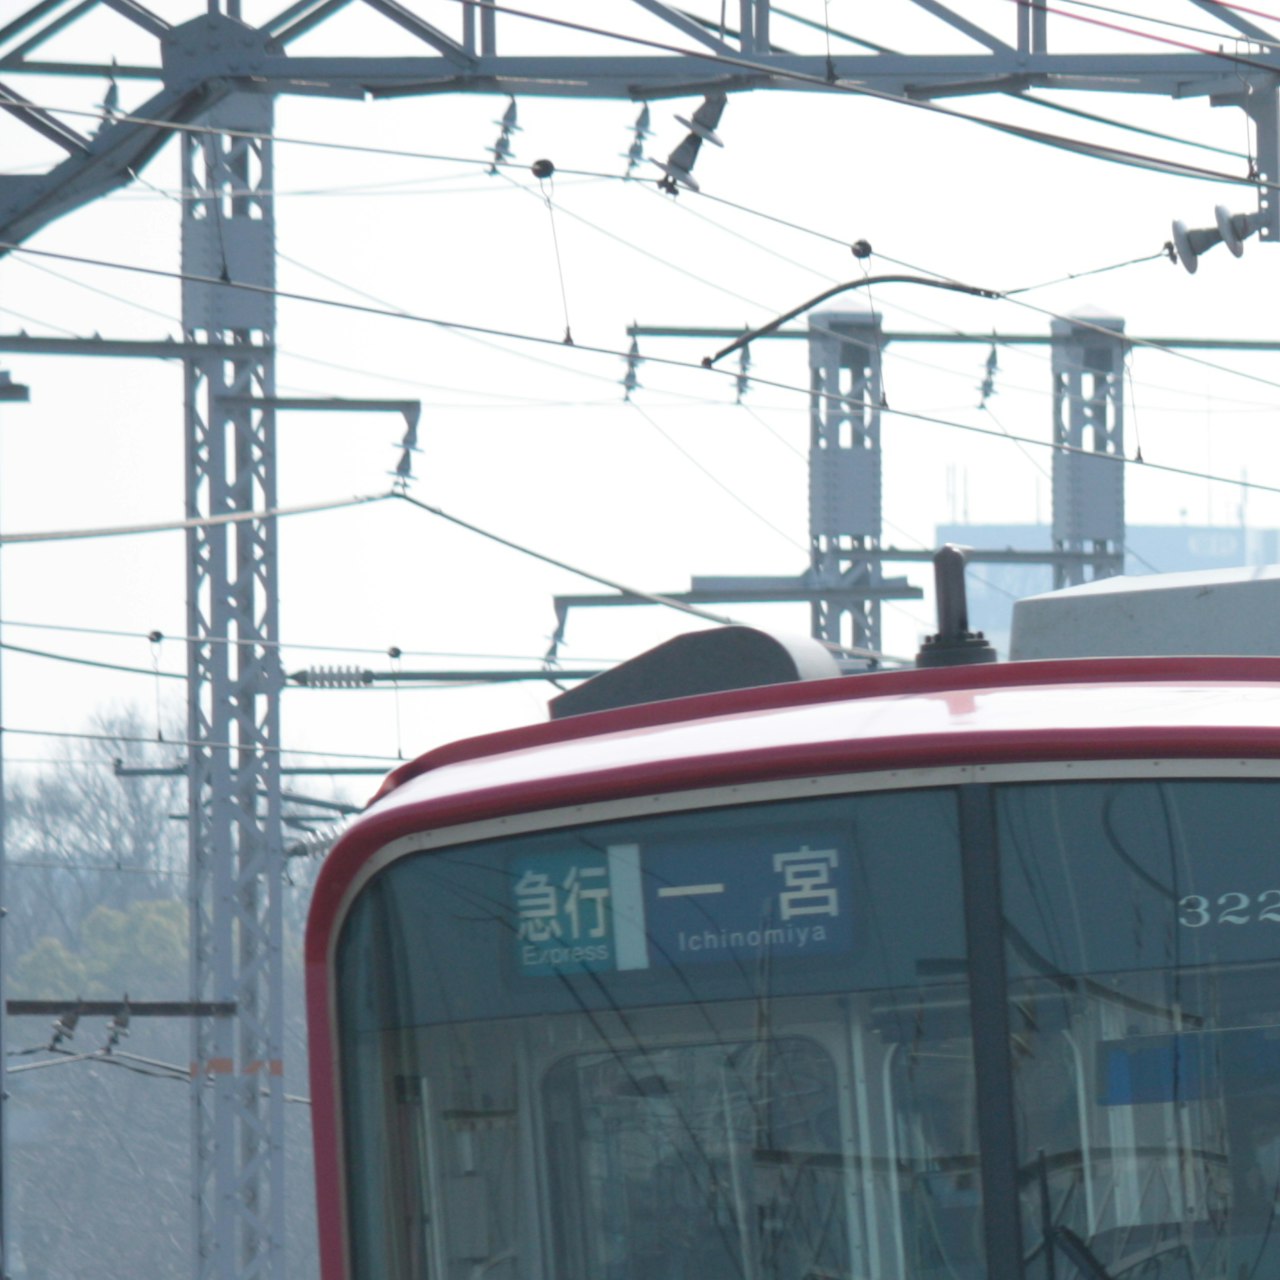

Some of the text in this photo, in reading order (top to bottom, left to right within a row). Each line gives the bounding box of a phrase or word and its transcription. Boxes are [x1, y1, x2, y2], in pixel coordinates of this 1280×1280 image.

[514, 865, 610, 942] 急行
[657, 845, 840, 921] 一宮
[522, 943, 609, 966] Express
[678, 923, 827, 951] Ichinomiya
